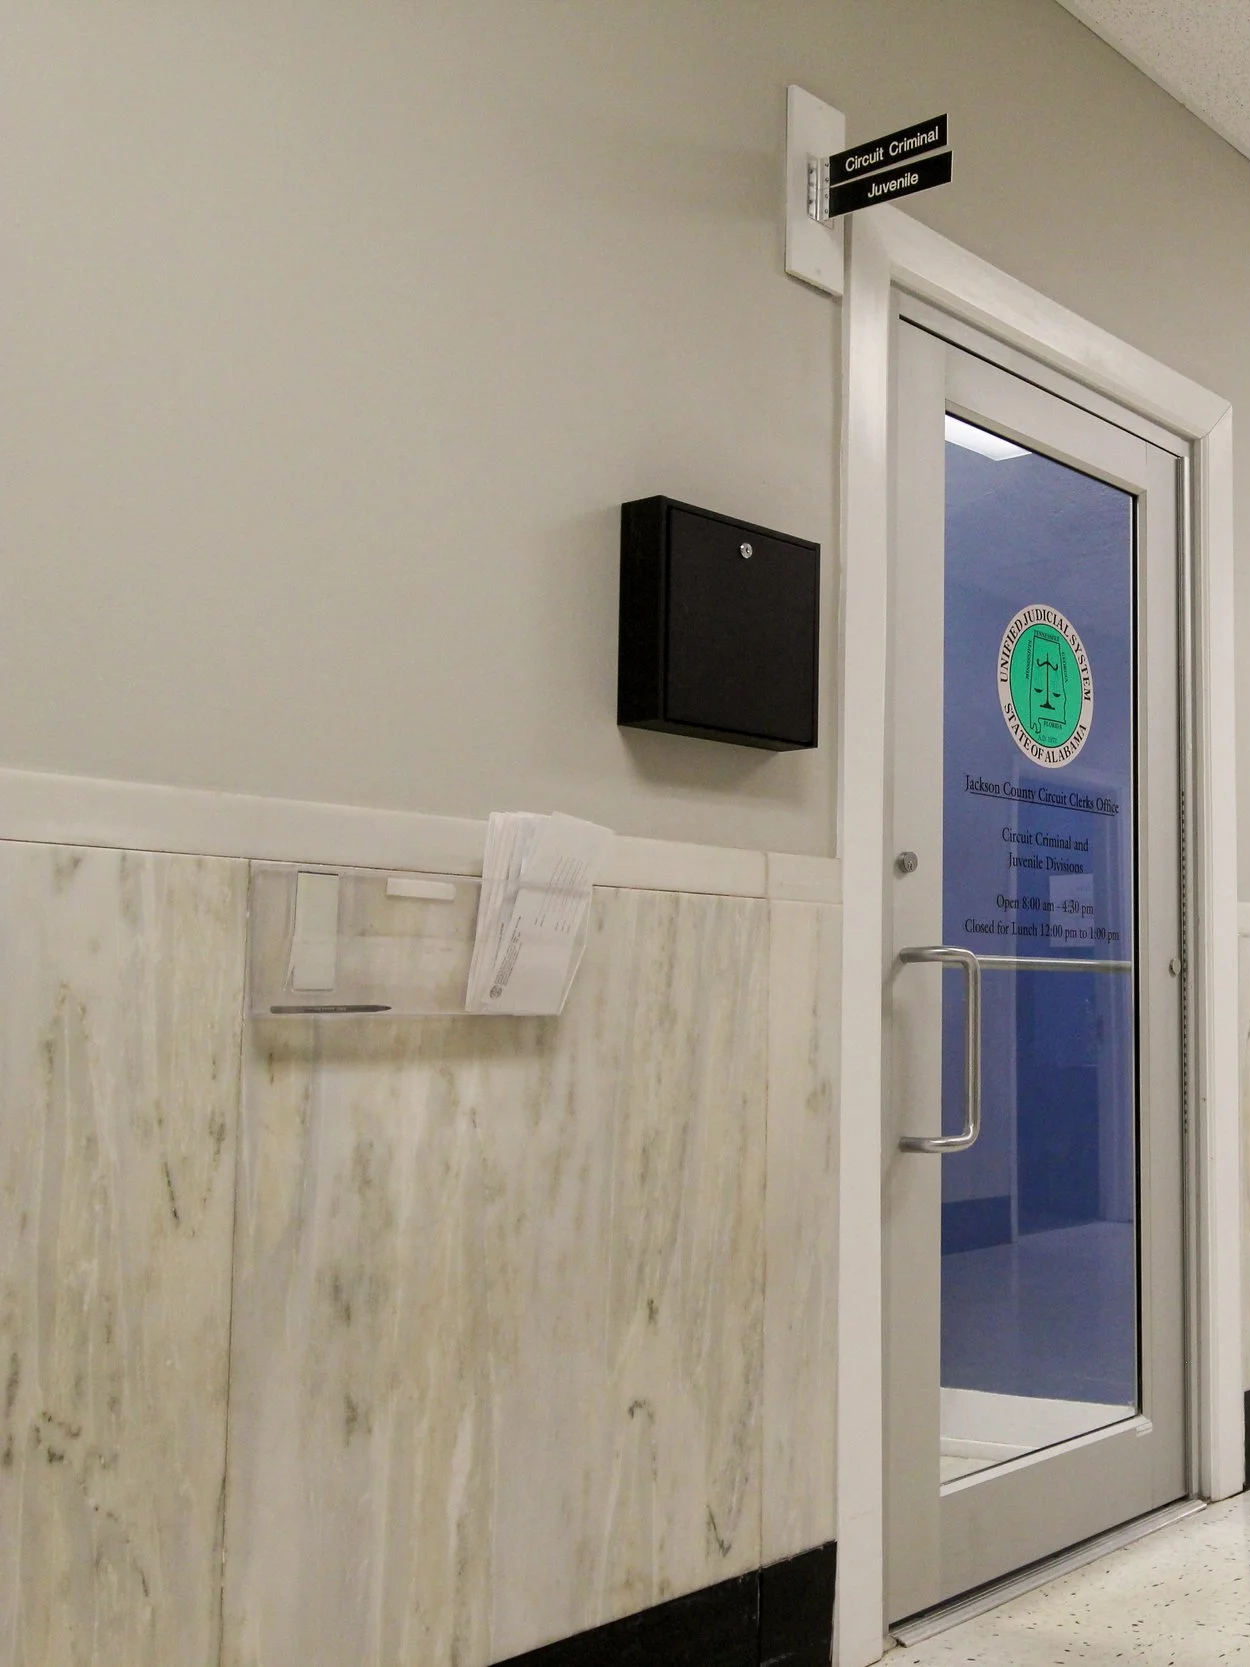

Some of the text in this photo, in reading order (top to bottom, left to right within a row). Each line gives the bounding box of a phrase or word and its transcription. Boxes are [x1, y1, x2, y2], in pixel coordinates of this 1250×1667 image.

[845, 126, 939, 172] Circuit Criminal
[867, 172, 919, 198] Juvenile
[1000, 608, 1091, 701] UNIFIED JUDICIAL SYSTEM
[1004, 703, 1087, 763] STATE OF ALABAMA
[965, 774, 1120, 814] Jackson County Circuit Clerks Office
[1002, 827, 1089, 852] Circuit Criminal and
[1008, 852, 1084, 873] Juvenile Divisions
[996, 894, 1019, 912] Open
[1022, 897, 1041, 911] 8:00
[1042, 902, 1054, 912] am
[1081, 904, 1094, 918] pm
[964, 918, 1120, 945] Closed for Lunch 12:00 pm to 1:00 pm
